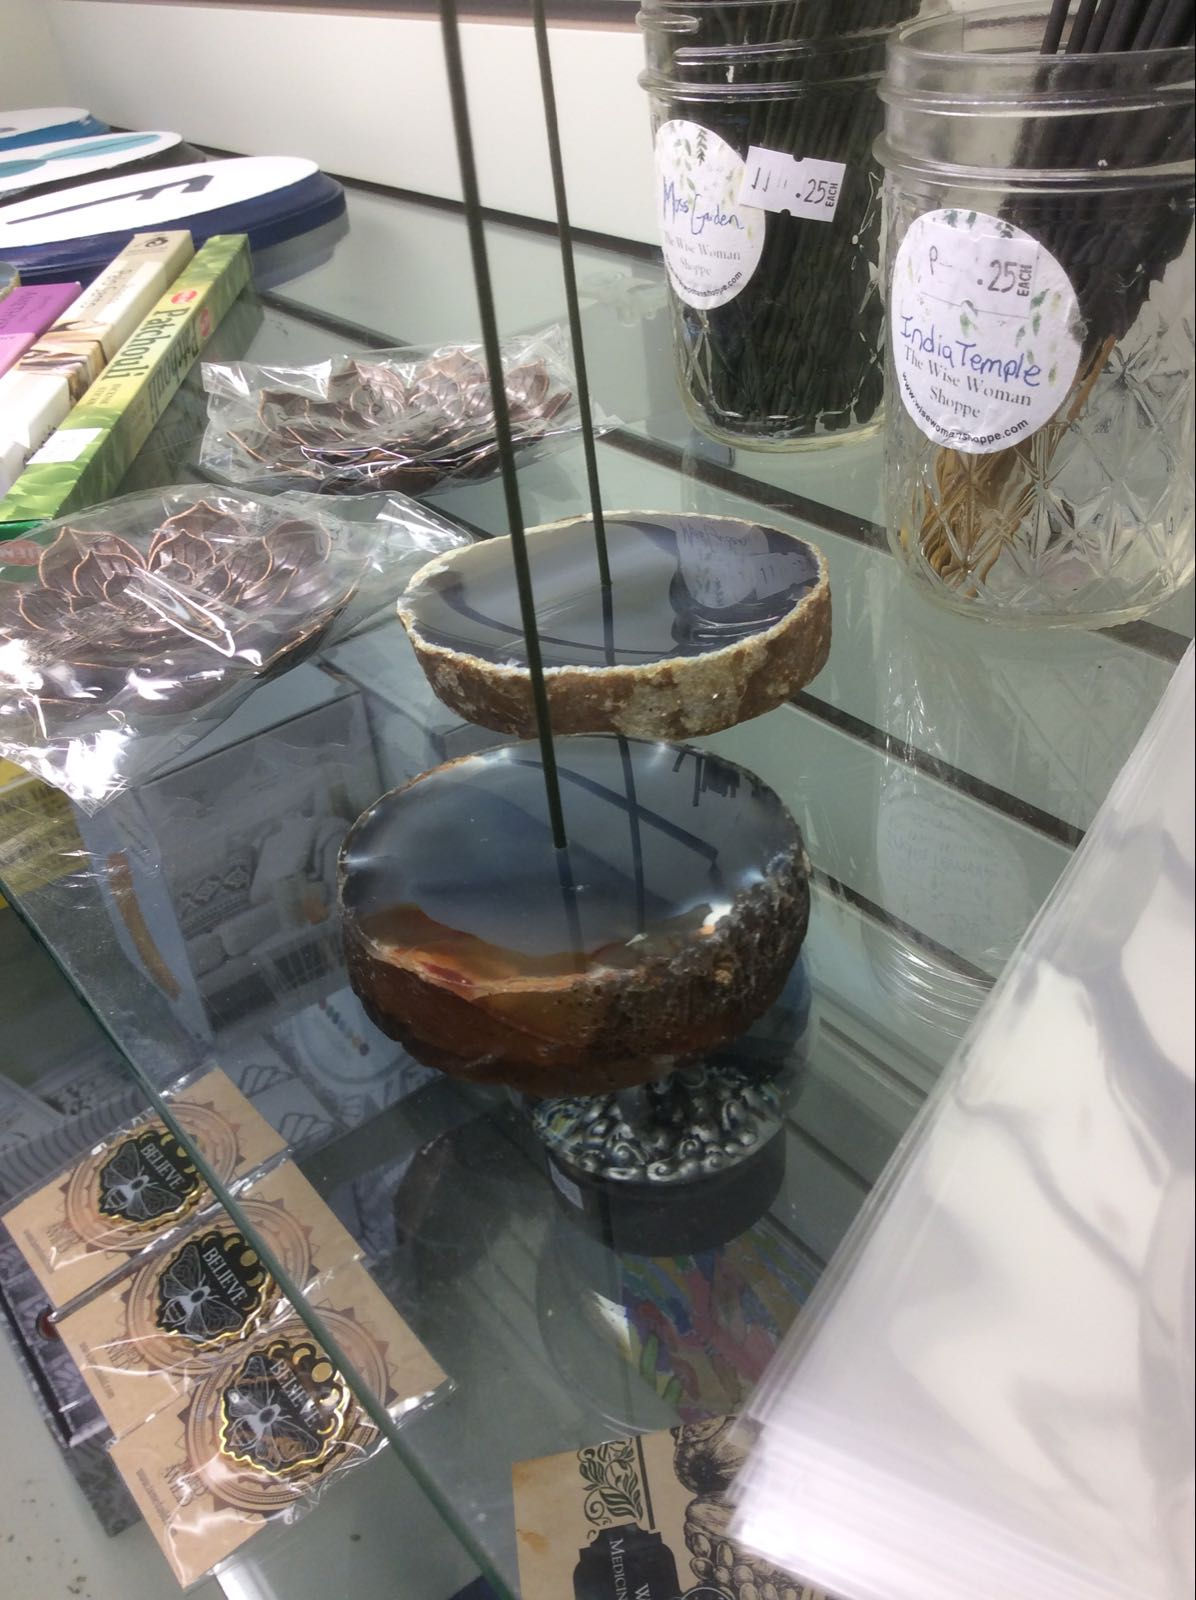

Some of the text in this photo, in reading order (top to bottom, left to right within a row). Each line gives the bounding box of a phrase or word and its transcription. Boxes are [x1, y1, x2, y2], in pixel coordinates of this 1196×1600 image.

[795, 178, 828, 204] .25
[825, 182, 838, 207] EACH
[977, 259, 1017, 293] .25
[1017, 264, 1032, 297] EACH
[102, 306, 191, 381] Patchouli
[900, 316, 1041, 387] India Temple
[904, 344, 1032, 406] The Wise Woman
[929, 385, 980, 418] Shoppe
[140, 1142, 186, 1190] BELIEVE
[202, 1246, 249, 1306] BELIEVE
[269, 1358, 325, 1429] BELIEVE
